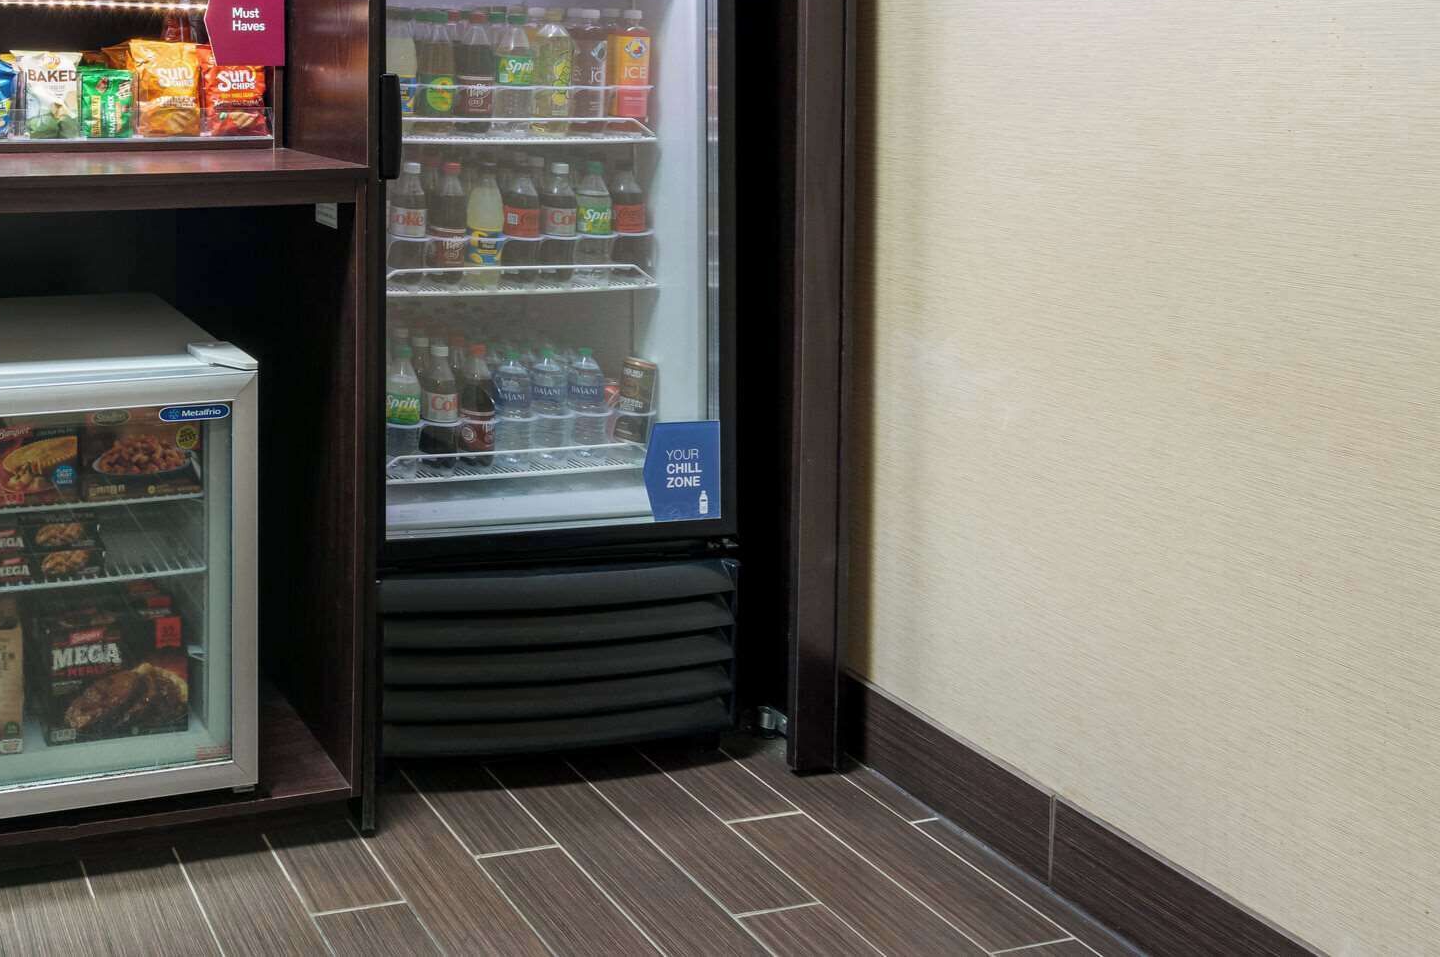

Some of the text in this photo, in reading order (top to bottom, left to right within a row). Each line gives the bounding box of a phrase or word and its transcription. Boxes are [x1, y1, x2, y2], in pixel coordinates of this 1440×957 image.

[232, 7, 260, 19] Must
[232, 20, 266, 31] Haves
[28, 70, 78, 83] BAKED
[623, 66, 648, 79] ICE
[216, 69, 256, 91] Sun
[231, 82, 256, 90] CHIPS
[181, 409, 222, 417] Metalfrio
[666, 448, 699, 461] YOUR
[666, 462, 703, 474] CHILL
[666, 475, 701, 488] ZONE
[51, 642, 122, 671] MEGA
